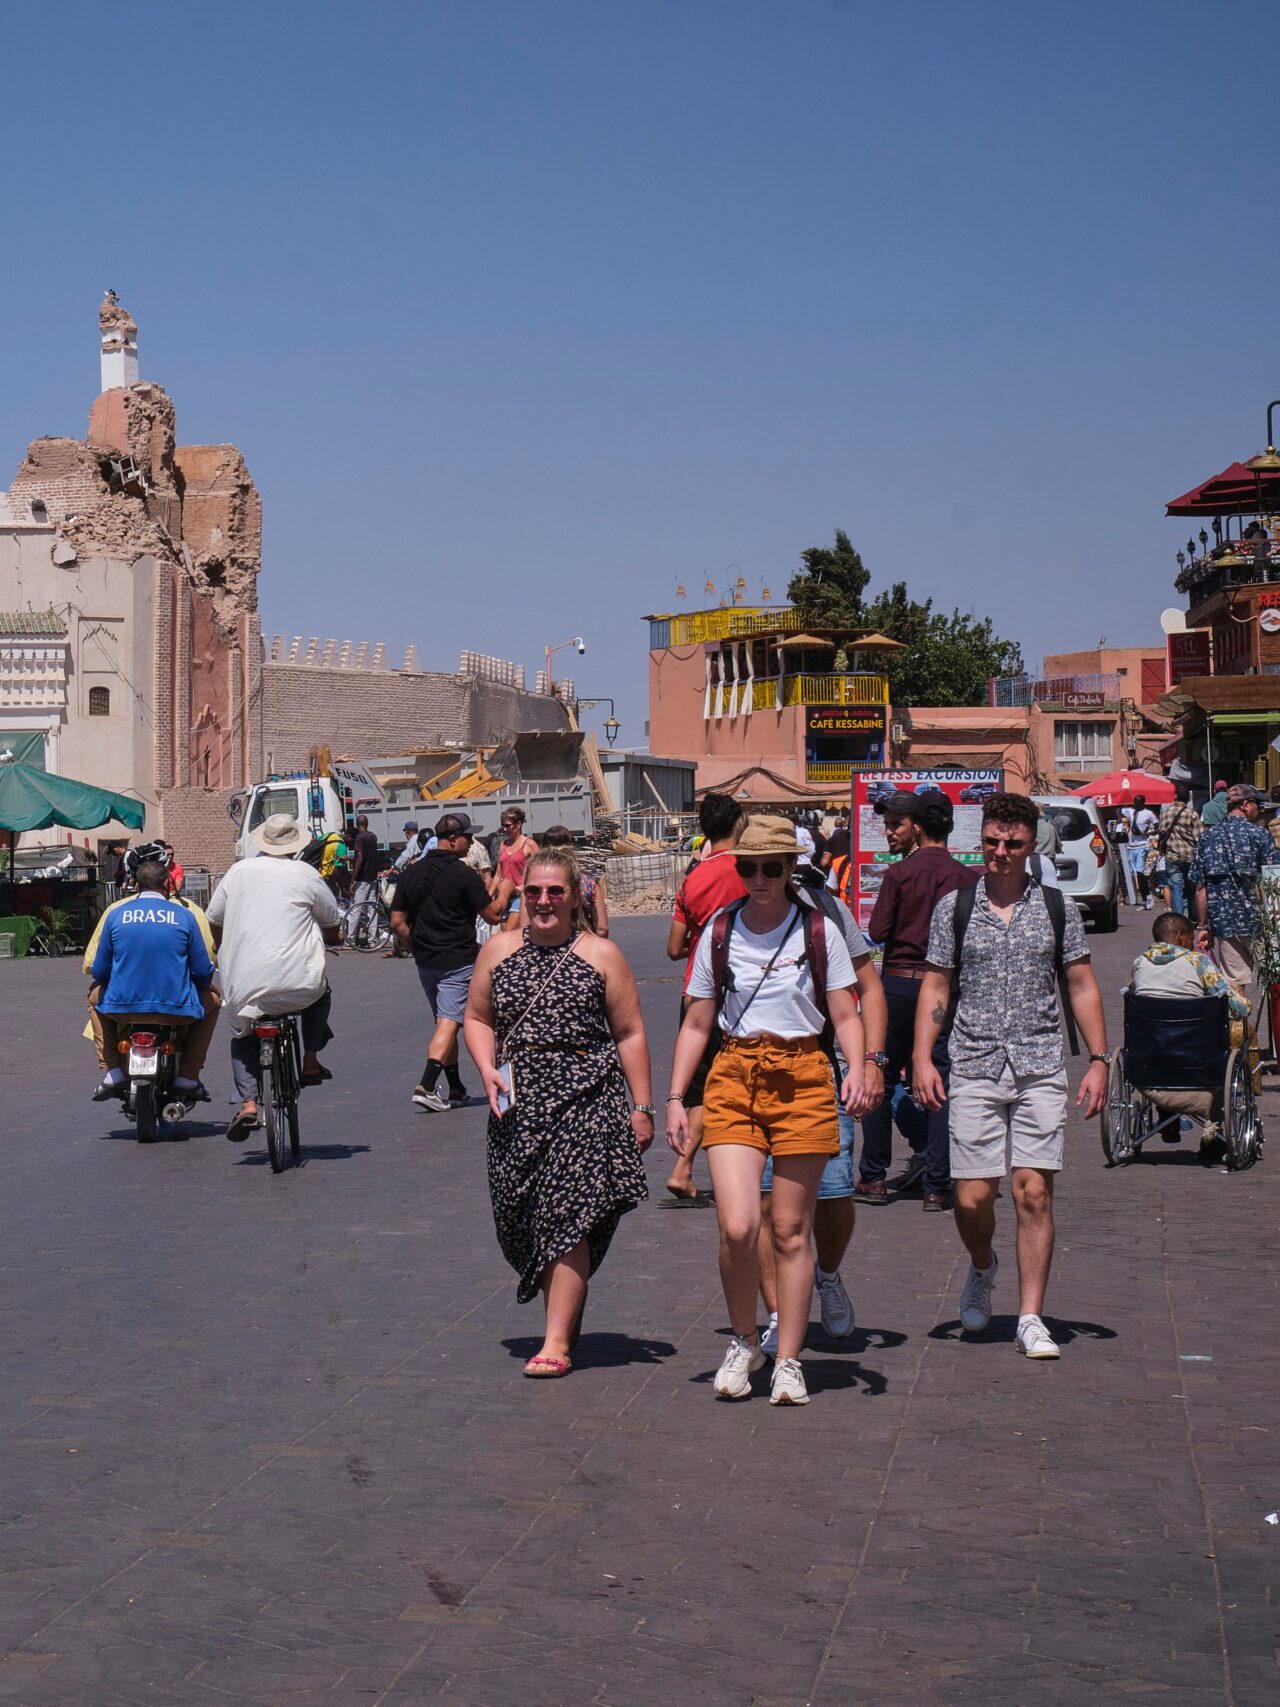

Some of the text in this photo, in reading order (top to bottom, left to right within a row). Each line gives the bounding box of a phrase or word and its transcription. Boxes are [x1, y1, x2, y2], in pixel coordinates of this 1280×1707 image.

[810, 717, 884, 729] CAFÉ KESSABINE
[335, 767, 368, 785] FUSO
[916, 771, 998, 780] EXCURSION
[122, 909, 180, 925] BRASIL
